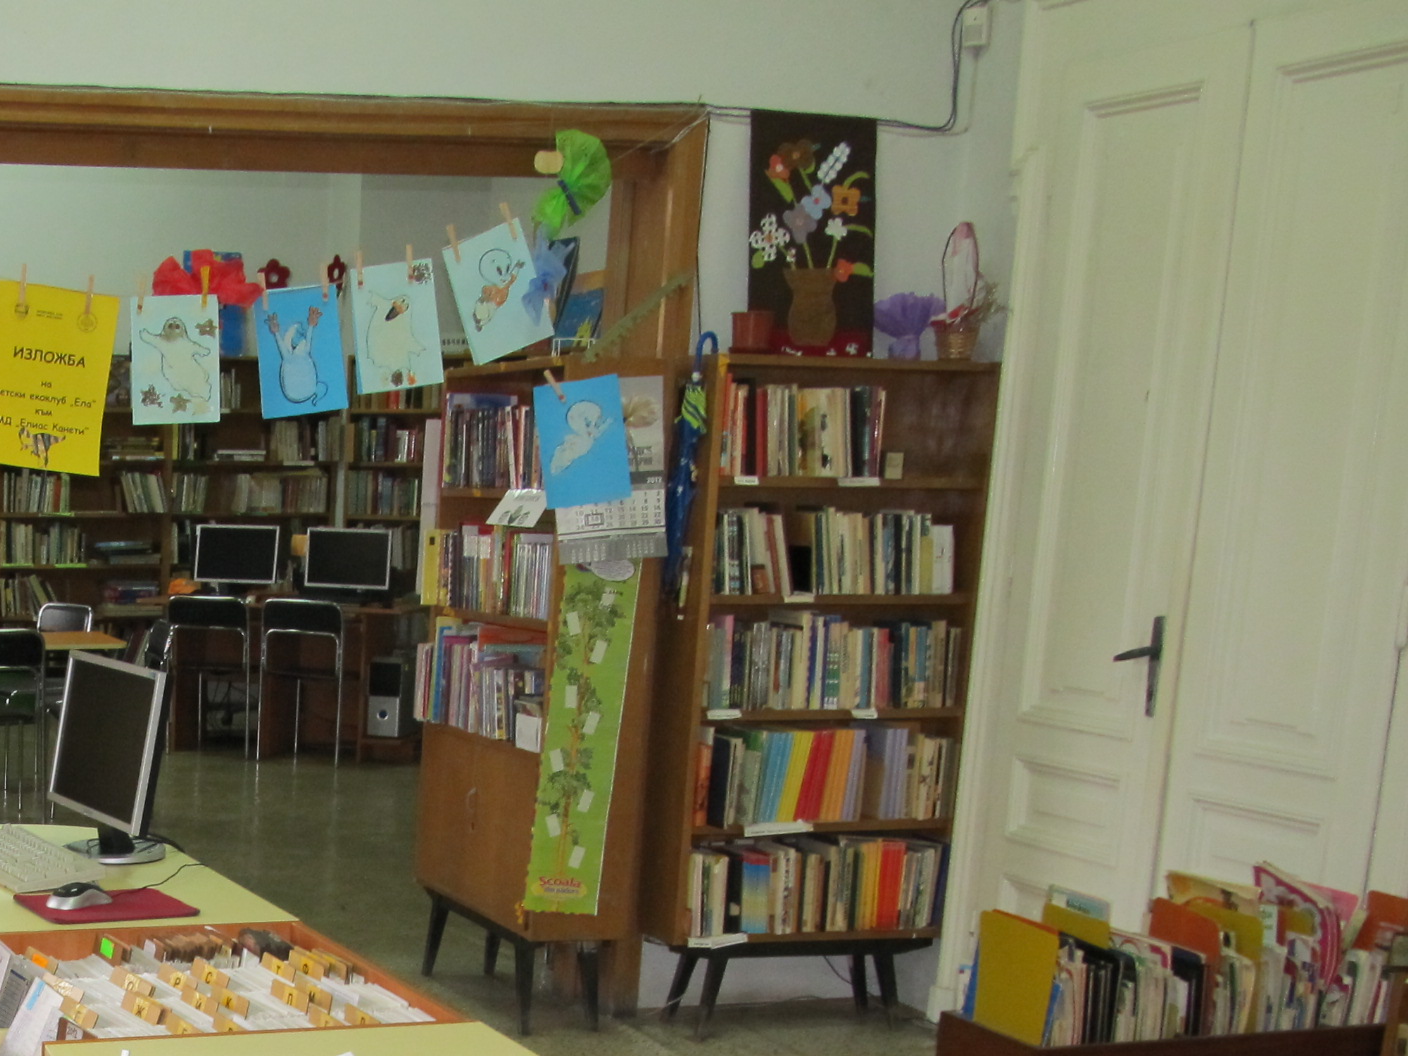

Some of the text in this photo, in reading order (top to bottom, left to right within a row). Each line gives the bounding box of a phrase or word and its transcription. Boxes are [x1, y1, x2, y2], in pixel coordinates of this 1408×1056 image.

[13, 346, 86, 368] ИЗЛОЖБА
[41, 380, 52, 388] на
[29, 393, 67, 405] екоклуб
